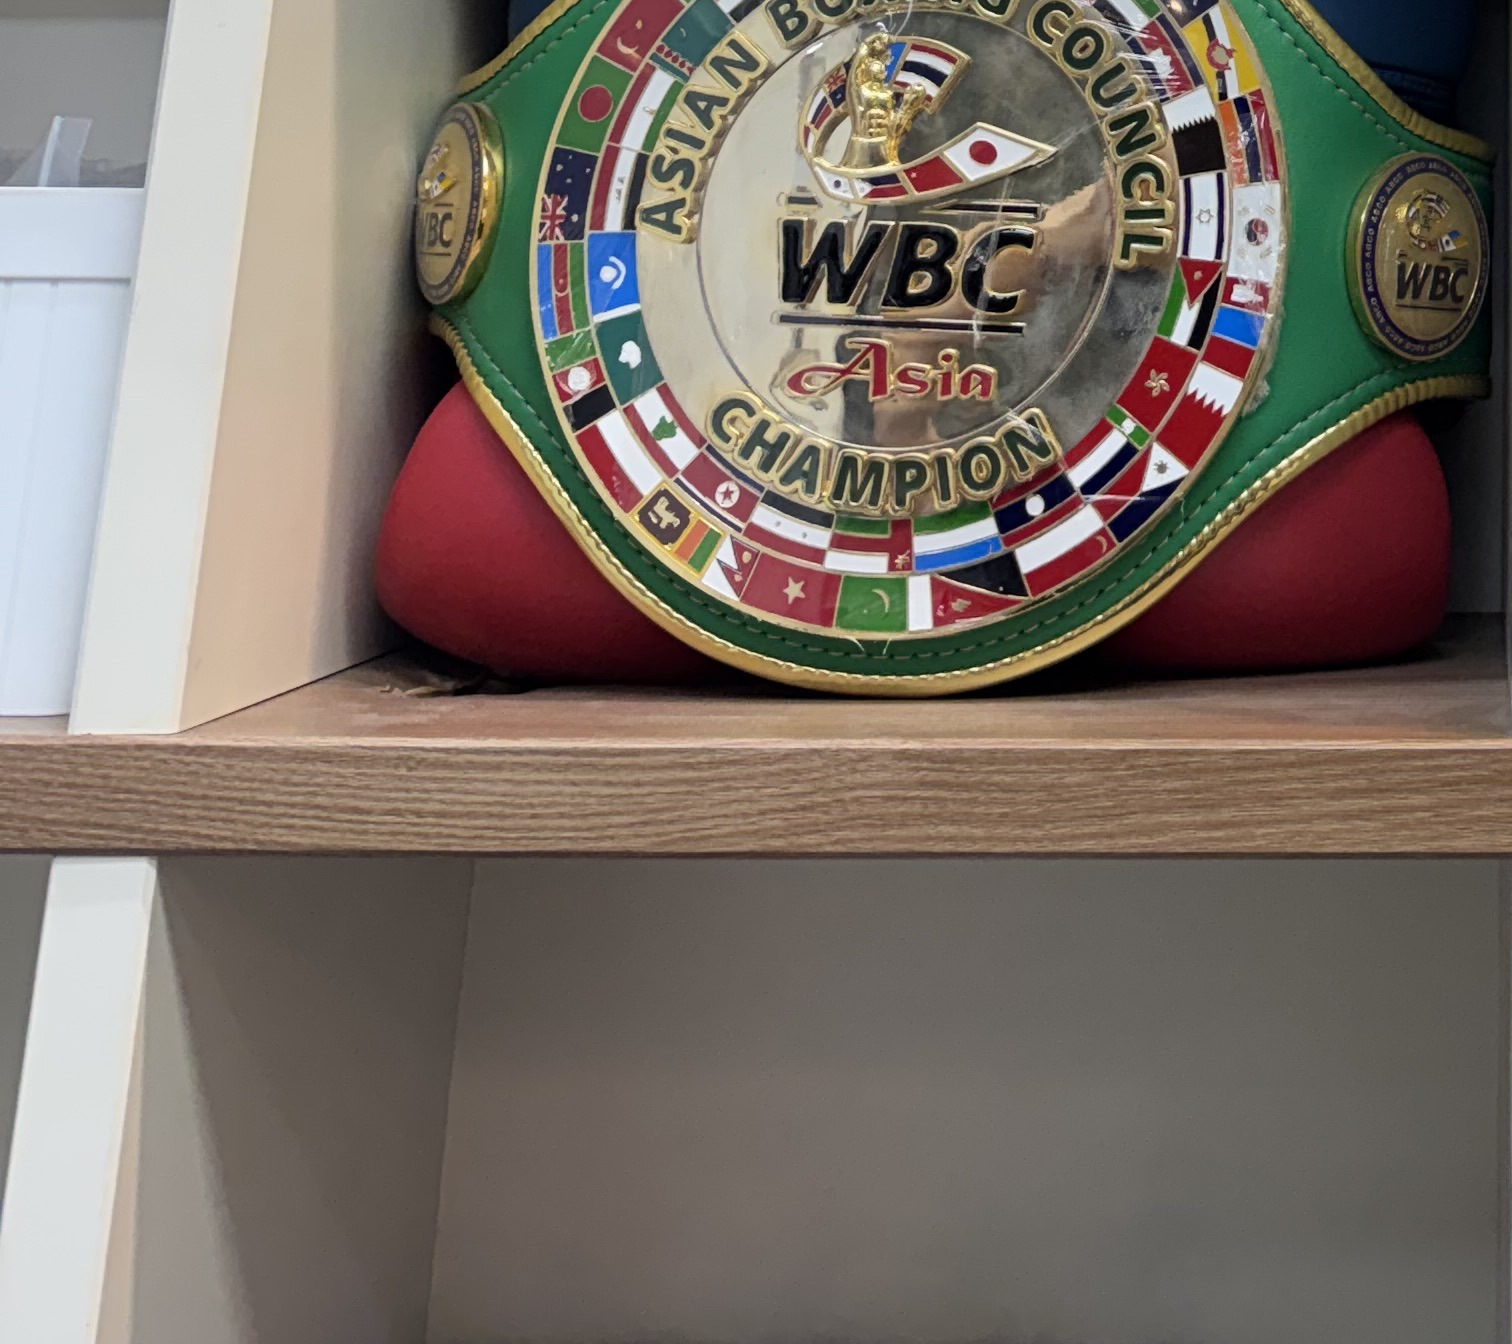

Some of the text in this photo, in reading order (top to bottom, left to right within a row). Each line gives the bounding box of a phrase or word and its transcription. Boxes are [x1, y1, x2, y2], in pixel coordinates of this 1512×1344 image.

[637, 32, 768, 242] ASIAN
[778, 215, 1037, 314] WBC
[1396, 261, 1469, 304] WBC
[786, 337, 997, 400] Asia
[708, 390, 1062, 512] CHAMPION
